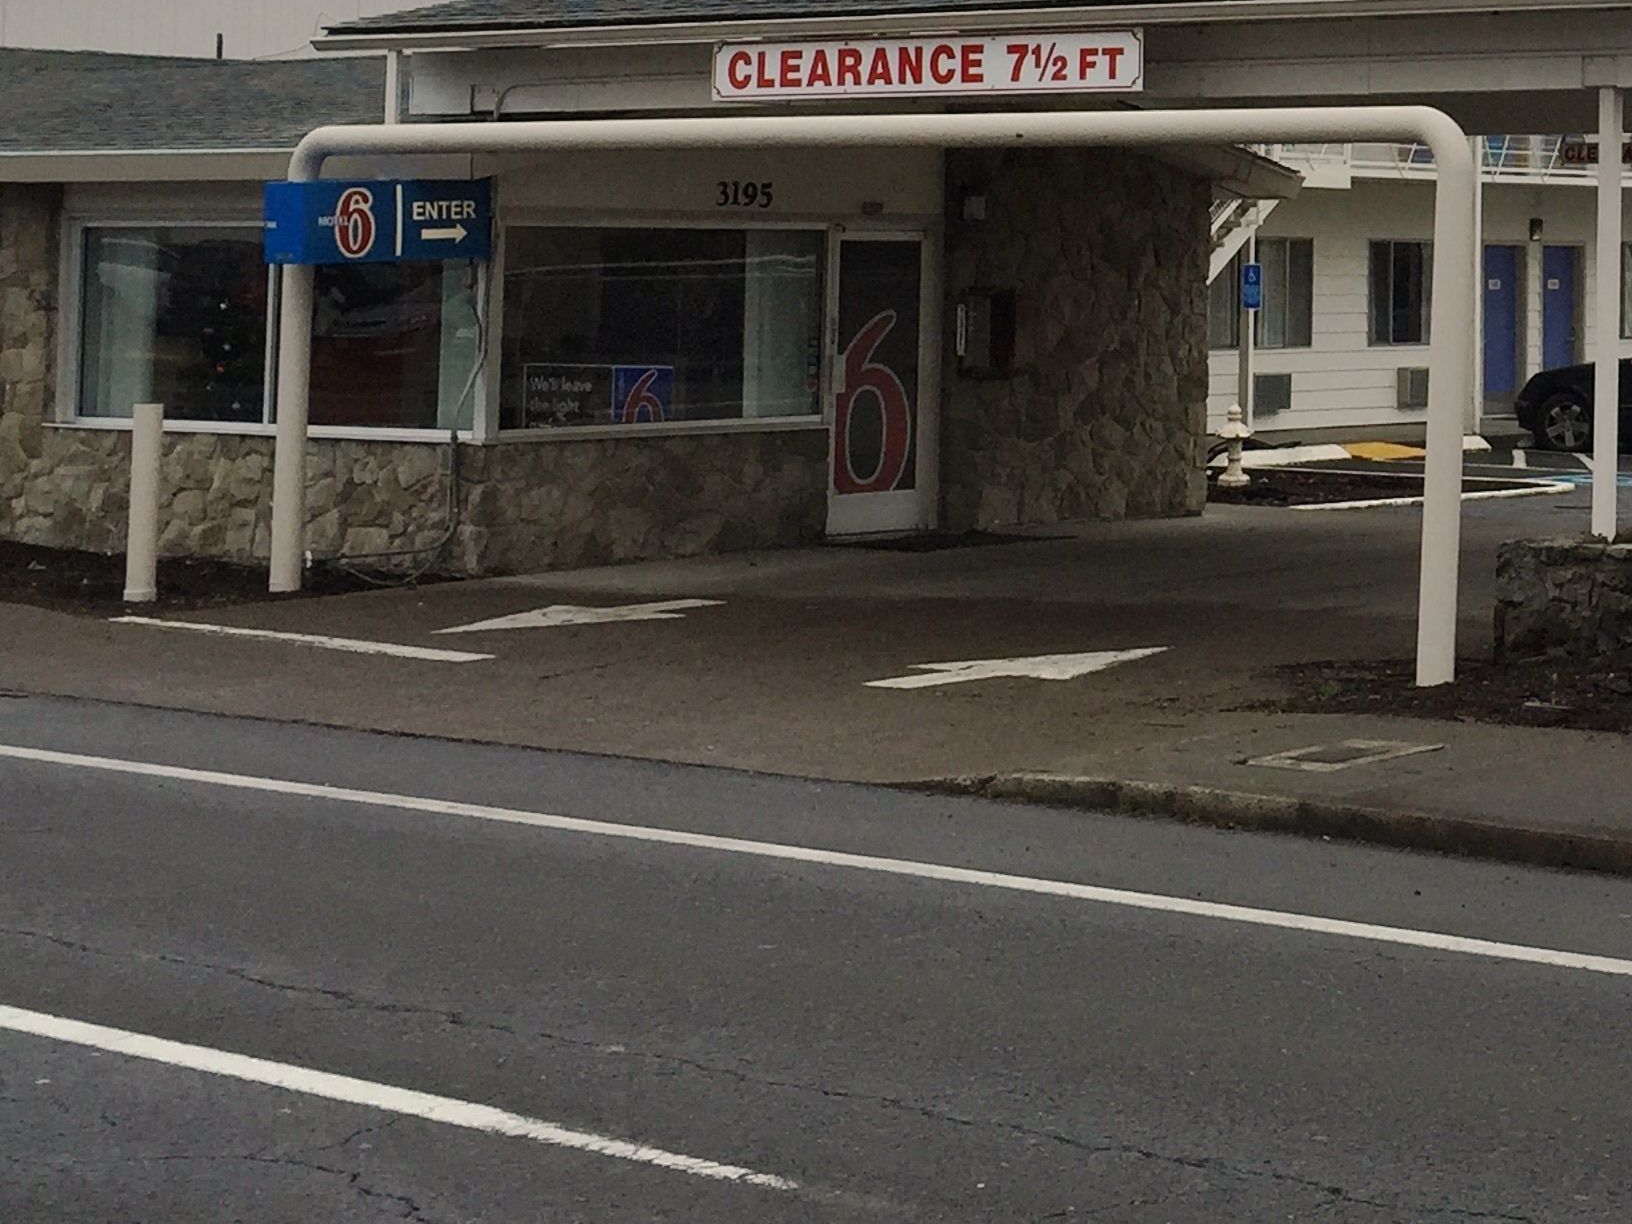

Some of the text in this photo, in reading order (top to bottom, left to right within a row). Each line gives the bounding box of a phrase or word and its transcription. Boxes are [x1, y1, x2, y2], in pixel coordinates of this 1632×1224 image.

[728, 45, 985, 90] CLEARANCE
[1080, 47, 1125, 80] FT
[412, 200, 477, 221] ENTER
[716, 181, 773, 209] 3195
[335, 187, 376, 258] 6
[833, 309, 911, 494] 6
